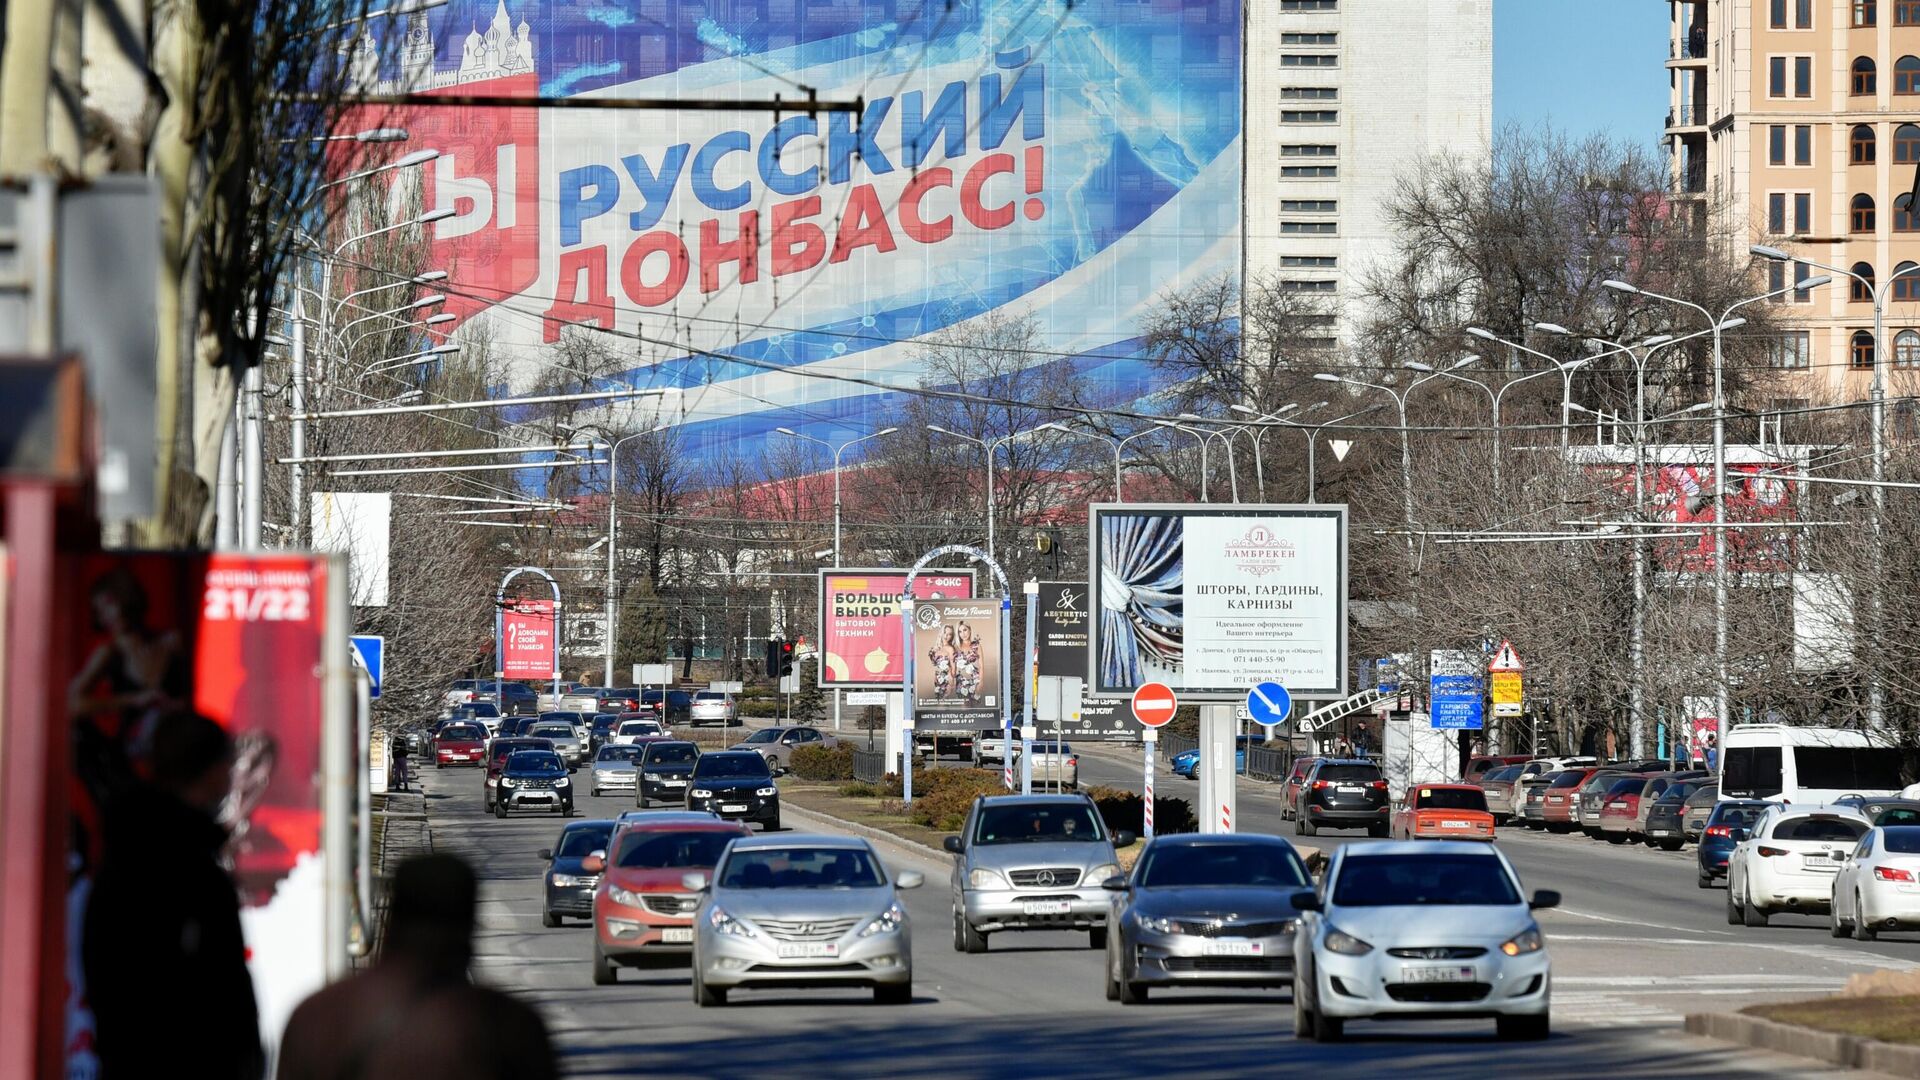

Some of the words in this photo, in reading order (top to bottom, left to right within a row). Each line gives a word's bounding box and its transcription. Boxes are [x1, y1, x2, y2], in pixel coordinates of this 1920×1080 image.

[559, 46, 1044, 247] РУССКИЙ
[543, 145, 1045, 344] ДОНБАСС!
[1255, 532, 1264, 541] Л
[1224, 550, 1296, 558] ЛАМБРЕКЕН
[935, 577, 962, 587] ФОКС
[1196, 585, 1251, 596] ШТОРЫ,
[1255, 585, 1323, 596] ГАРДИНЫ,
[204, 588, 310, 621] 21/22
[1227, 599, 1293, 609] КАРНИЗЫ
[835, 607, 892, 617] ВЫБОР
[835, 619, 876, 627] БЫТОВОЙ
[1257, 621, 1304, 629] оформление
